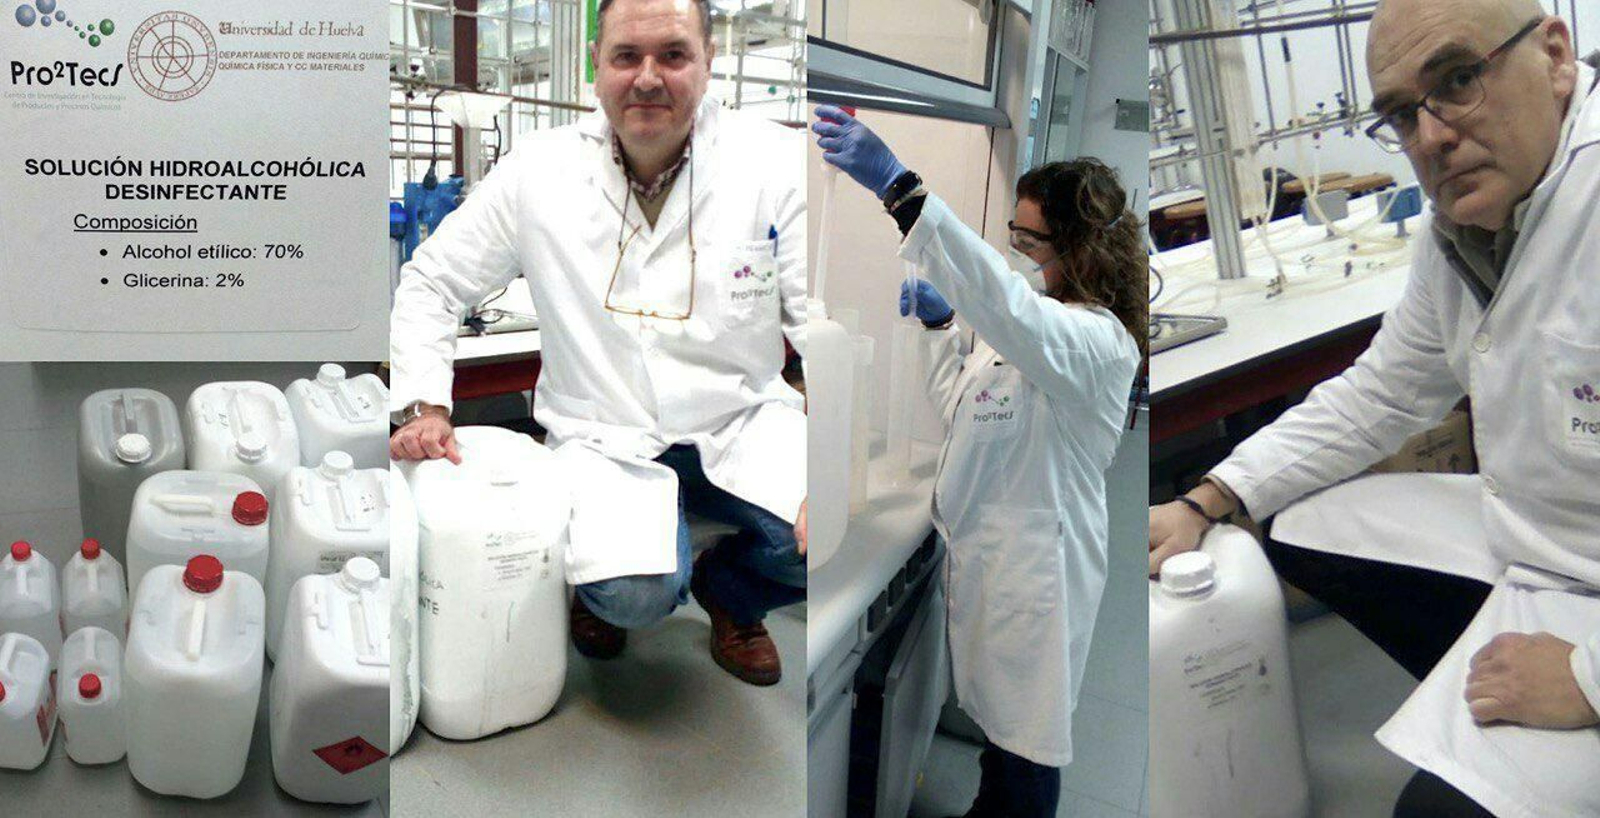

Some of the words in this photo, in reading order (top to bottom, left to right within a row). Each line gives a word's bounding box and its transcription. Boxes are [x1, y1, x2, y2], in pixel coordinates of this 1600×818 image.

[218, 20, 293, 37] Universidad
[299, 21, 317, 36] de
[318, 21, 364, 37] Huelva
[219, 50, 291, 60] DEPARTAMENTO
[292, 51, 304, 60] DE
[306, 50, 356, 60] INGENIERÍA
[218, 61, 254, 71] QUÍMICA
[256, 61, 285, 71] FÍSICA
[286, 63, 293, 71] Y
[294, 63, 307, 71] CC
[310, 63, 365, 72] MATERIALES
[24, 155, 143, 177] SOLUCIÓN
[150, 156, 366, 178] HIDROALCOHÓLICA
[105, 183, 287, 201] DESINFECTANTE
[73, 213, 198, 232] Composición
[122, 244, 192, 260] Alcohol
[198, 244, 257, 260] etílico:
[264, 244, 304, 260] 70%
[123, 272, 209, 288] Glicerina:
[215, 273, 245, 288] 2%
